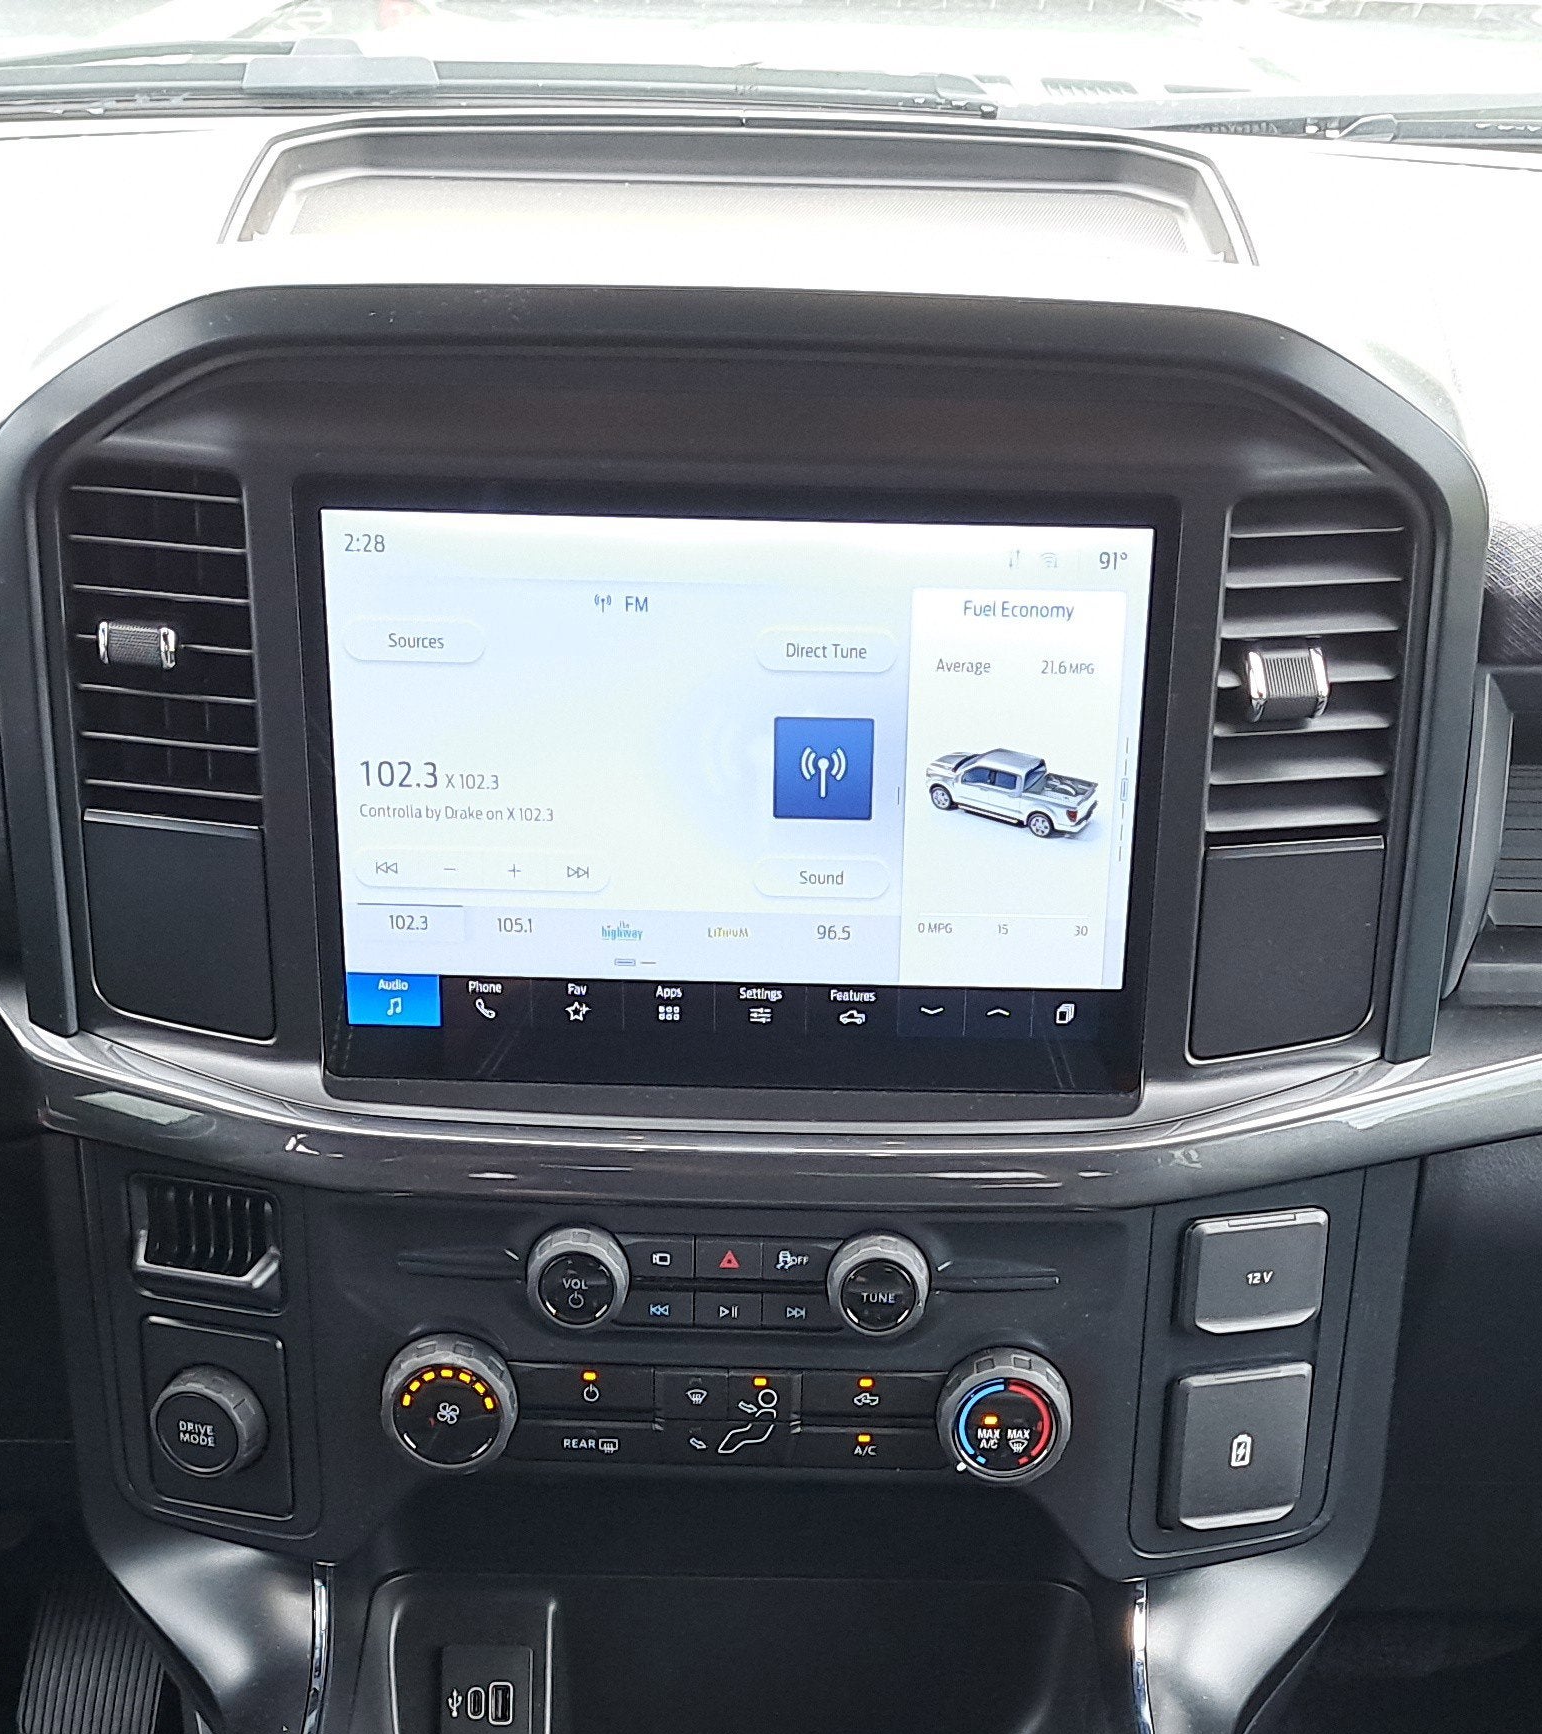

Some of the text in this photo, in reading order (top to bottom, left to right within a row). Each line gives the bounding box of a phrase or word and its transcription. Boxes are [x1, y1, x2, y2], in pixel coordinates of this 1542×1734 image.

[344, 533, 386, 553] 2:28
[1098, 551, 1128, 571] 91°
[625, 596, 649, 613] FM
[963, 601, 1075, 622] Fuel Economy
[388, 633, 444, 650] Sources
[786, 643, 867, 660] Direct Tune
[936, 658, 991, 676] Average
[1041, 660, 1095, 675] 21.6 MPG
[360, 761, 499, 790] 102.3 X 102.3
[359, 803, 554, 823] Controlla by Drake on X 102.3
[799, 870, 844, 886] Sound
[388, 914, 428, 931] 102.3
[497, 917, 534, 933] 105.1
[918, 922, 953, 935] 0 MPG
[997, 923, 1009, 936] 15
[601, 925, 643, 941] highway
[816, 924, 851, 941] 96.5
[1074, 925, 1089, 937] 30
[377, 979, 409, 992] Audio
[468, 981, 502, 995] Phone
[567, 983, 588, 997] Fav
[655, 986, 683, 1001] Apps
[739, 987, 783, 1002] Settings
[830, 989, 876, 1003] Features
[791, 1256, 809, 1266] OFF
[562, 1278, 589, 1290] VOL
[860, 1292, 896, 1303] TUNE
[179, 1420, 214, 1436] DRIVE
[977, 1428, 1000, 1440] MAX
[1007, 1428, 1030, 1440] MAX
[179, 1432, 215, 1447] MODE
[563, 1438, 596, 1450] REAR
[979, 1438, 998, 1450] A/C
[854, 1445, 877, 1456] A/C
